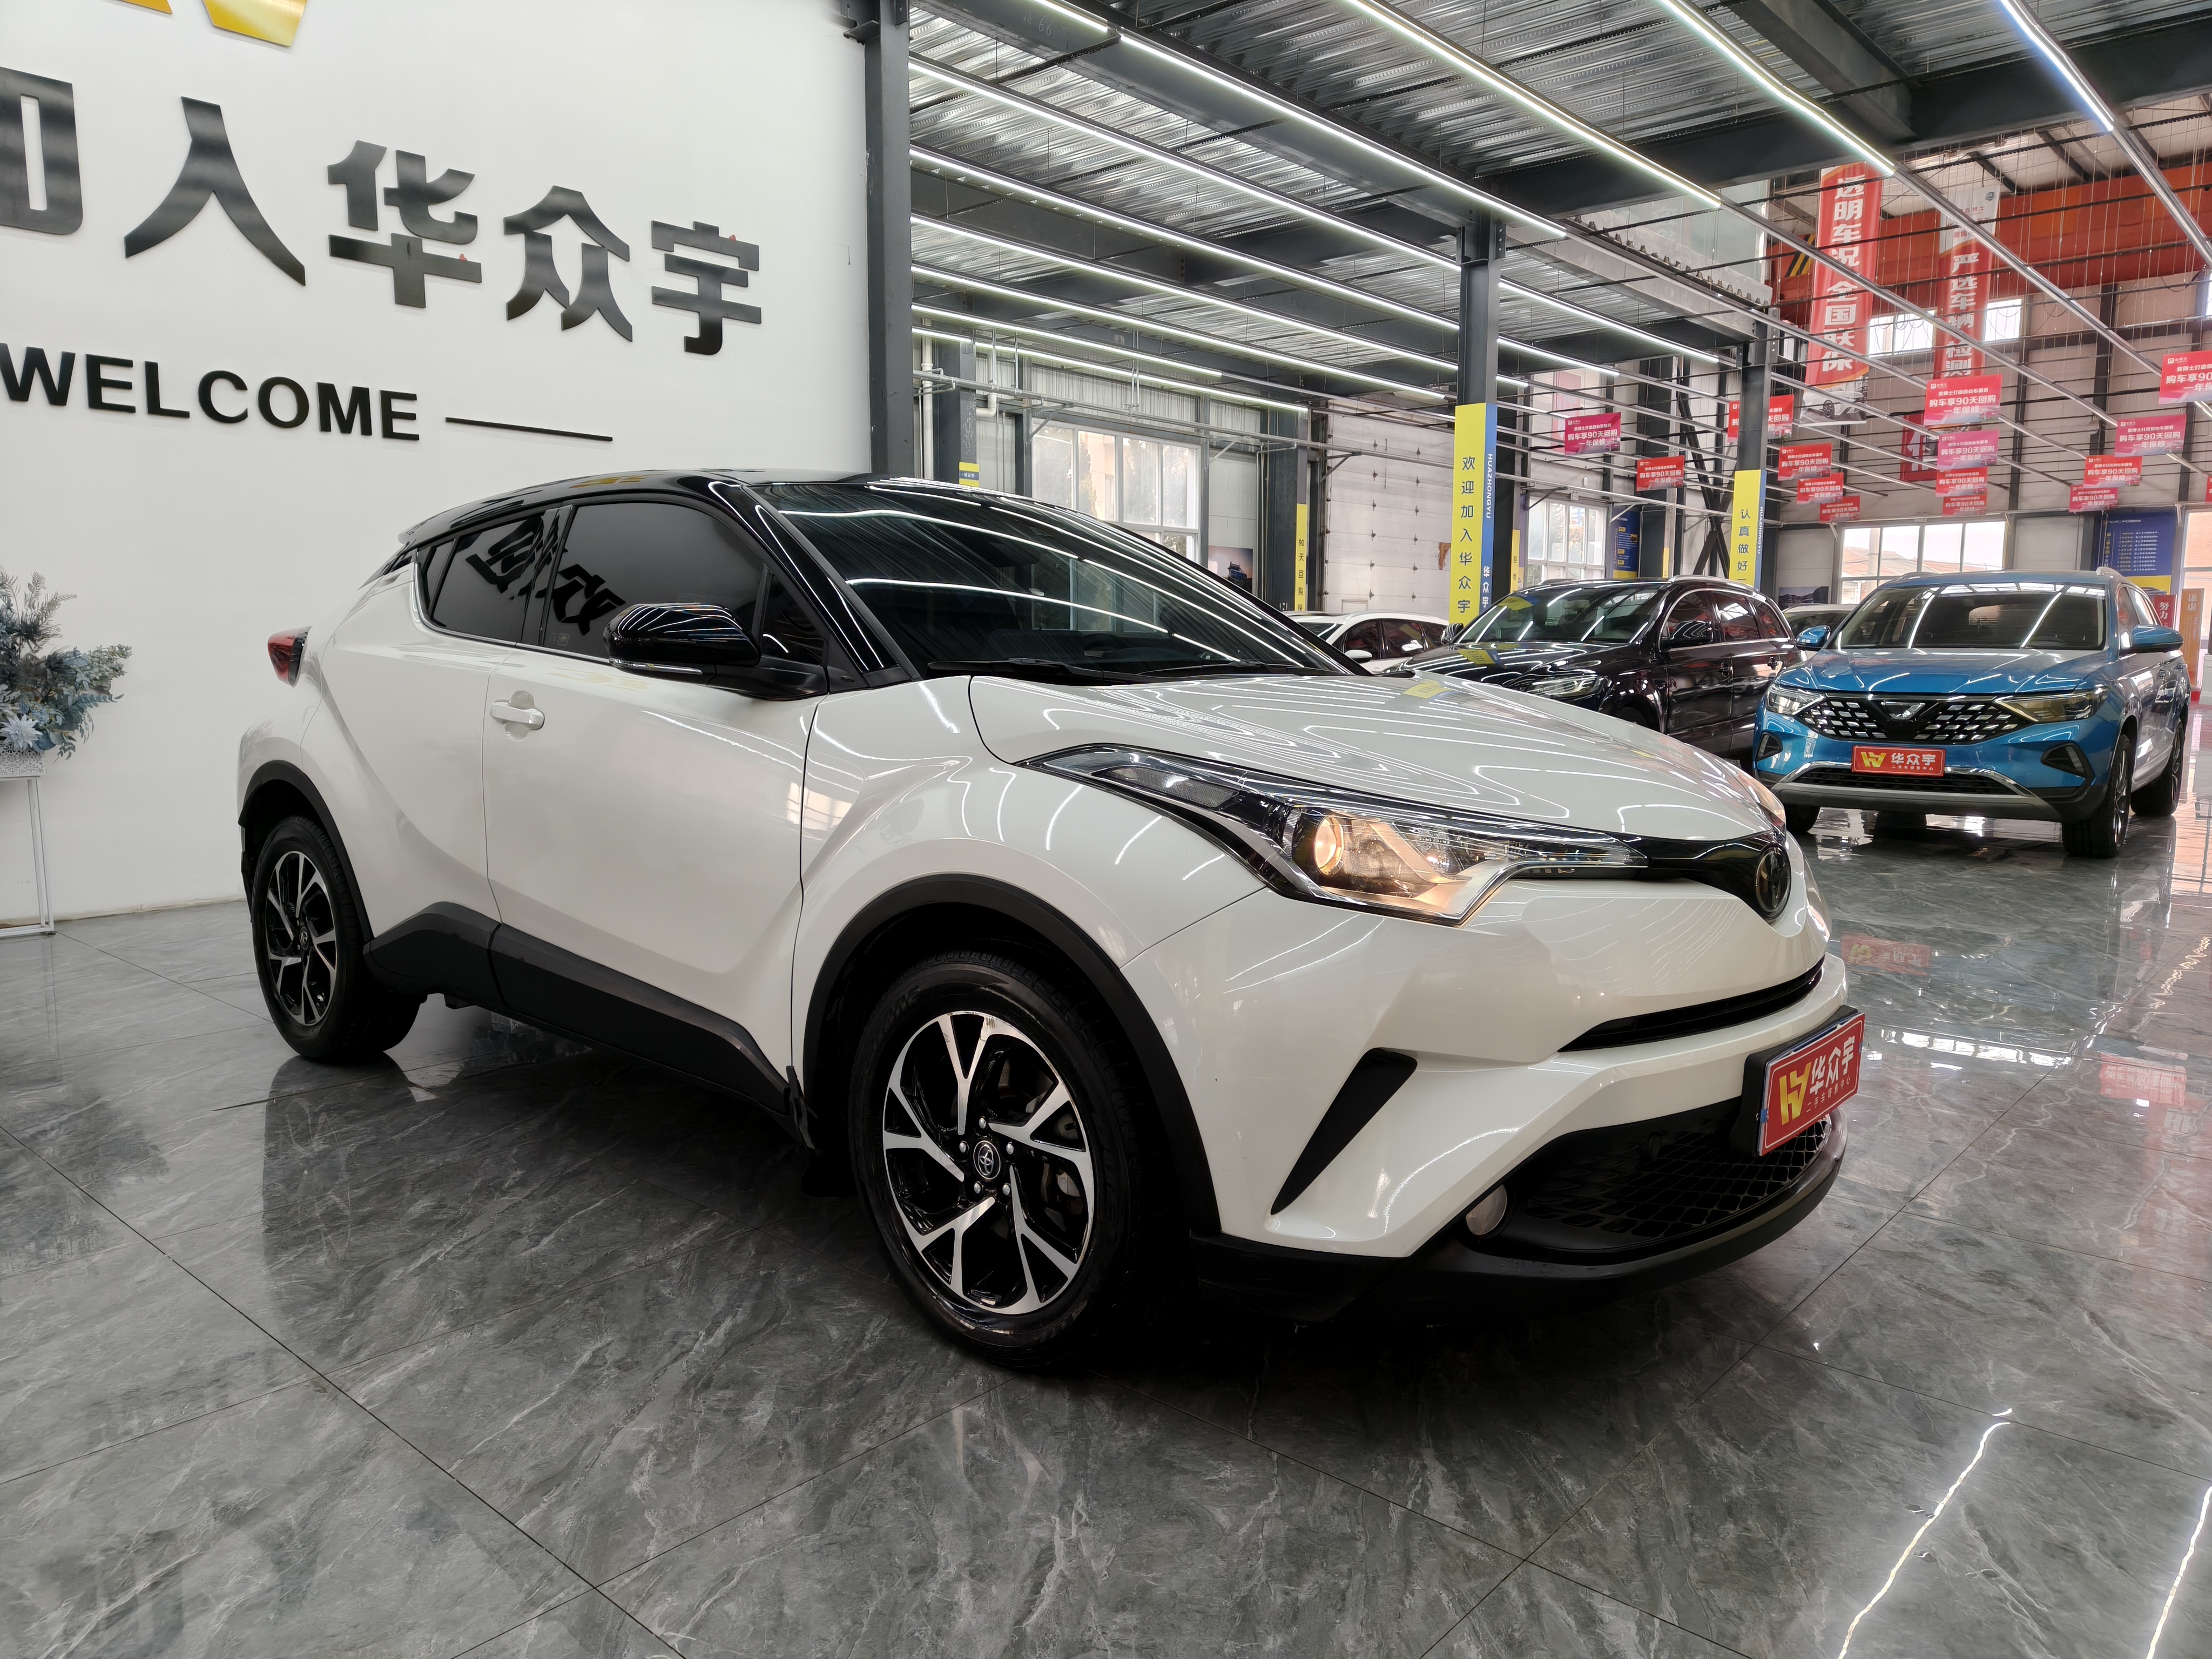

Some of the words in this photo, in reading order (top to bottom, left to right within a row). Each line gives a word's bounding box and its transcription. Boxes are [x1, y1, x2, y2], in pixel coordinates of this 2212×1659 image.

[0, 342, 420, 442] WELCOME
[1929, 394, 1997, 407] 购车享90天回购
[1944, 406, 1980, 415] 一年保修
[1568, 429, 1617, 441] 购车享90天回购
[2119, 431, 2181, 442] 购车享90天回购
[1941, 446, 1994, 455] 购车享90天回购
[1782, 458, 1829, 467] 购车享90天回购
[1640, 470, 1681, 478] 购车享90天回购
[1458, 456, 1476, 613] 欢迎加入华众宇
[1482, 565, 1490, 608] 华众宇
[1891, 752, 1936, 765] 华众宇
[1810, 1035, 1856, 1095] 华众宇
